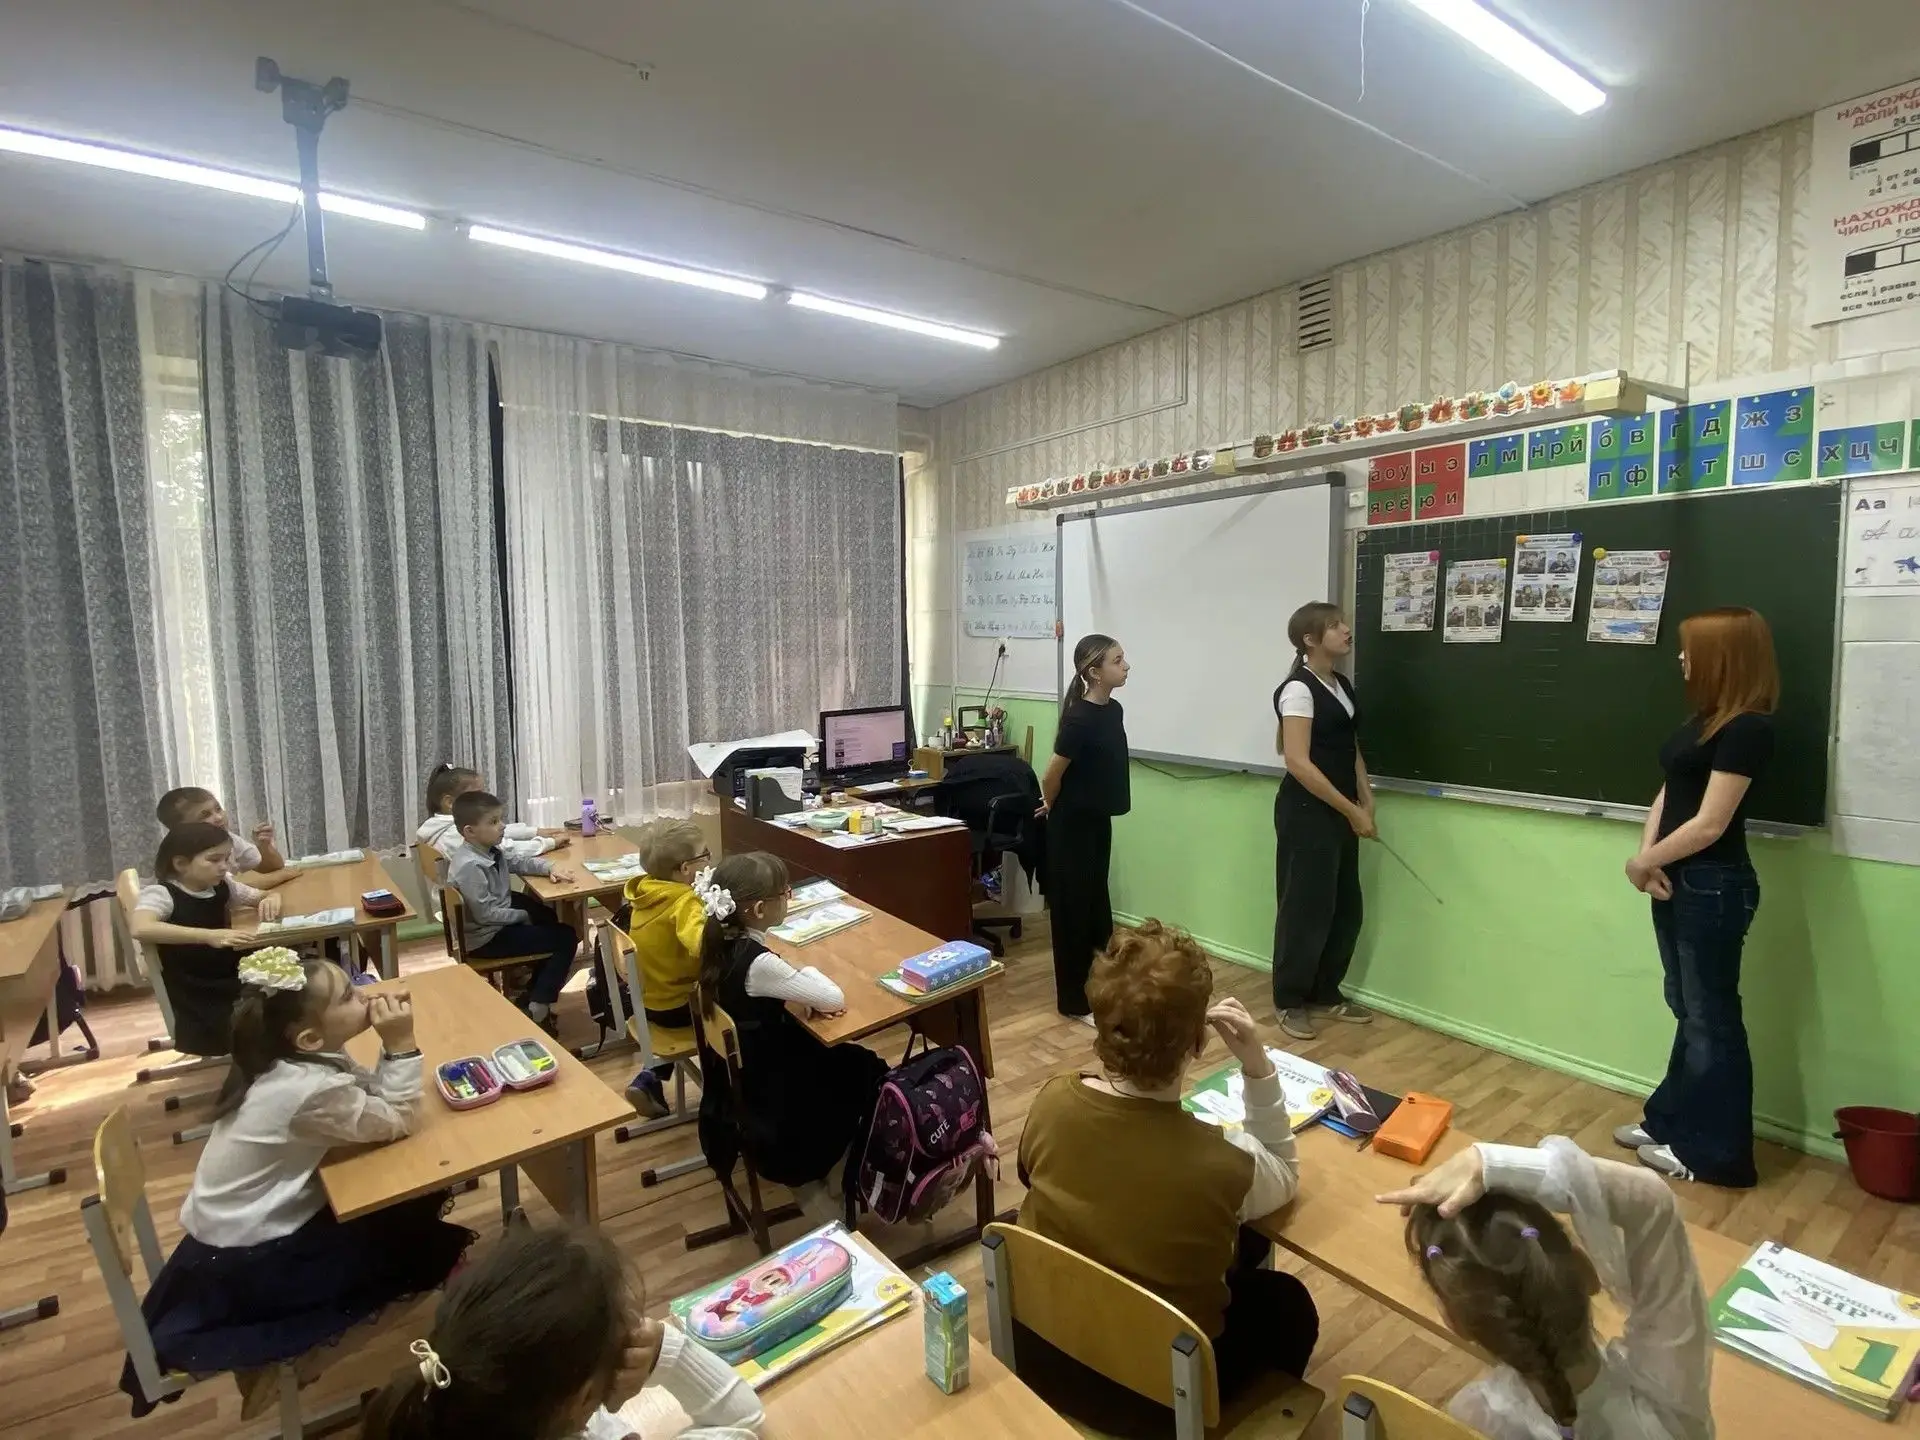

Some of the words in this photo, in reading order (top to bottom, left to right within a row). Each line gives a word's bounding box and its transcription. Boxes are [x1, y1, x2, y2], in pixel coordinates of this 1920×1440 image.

[1853, 103, 1899, 128] ДОЛИ
[1837, 217, 1893, 237] ЧИСЛА
[930, 1119, 950, 1144] CUTE
[1839, 1336, 1899, 1389] 1
